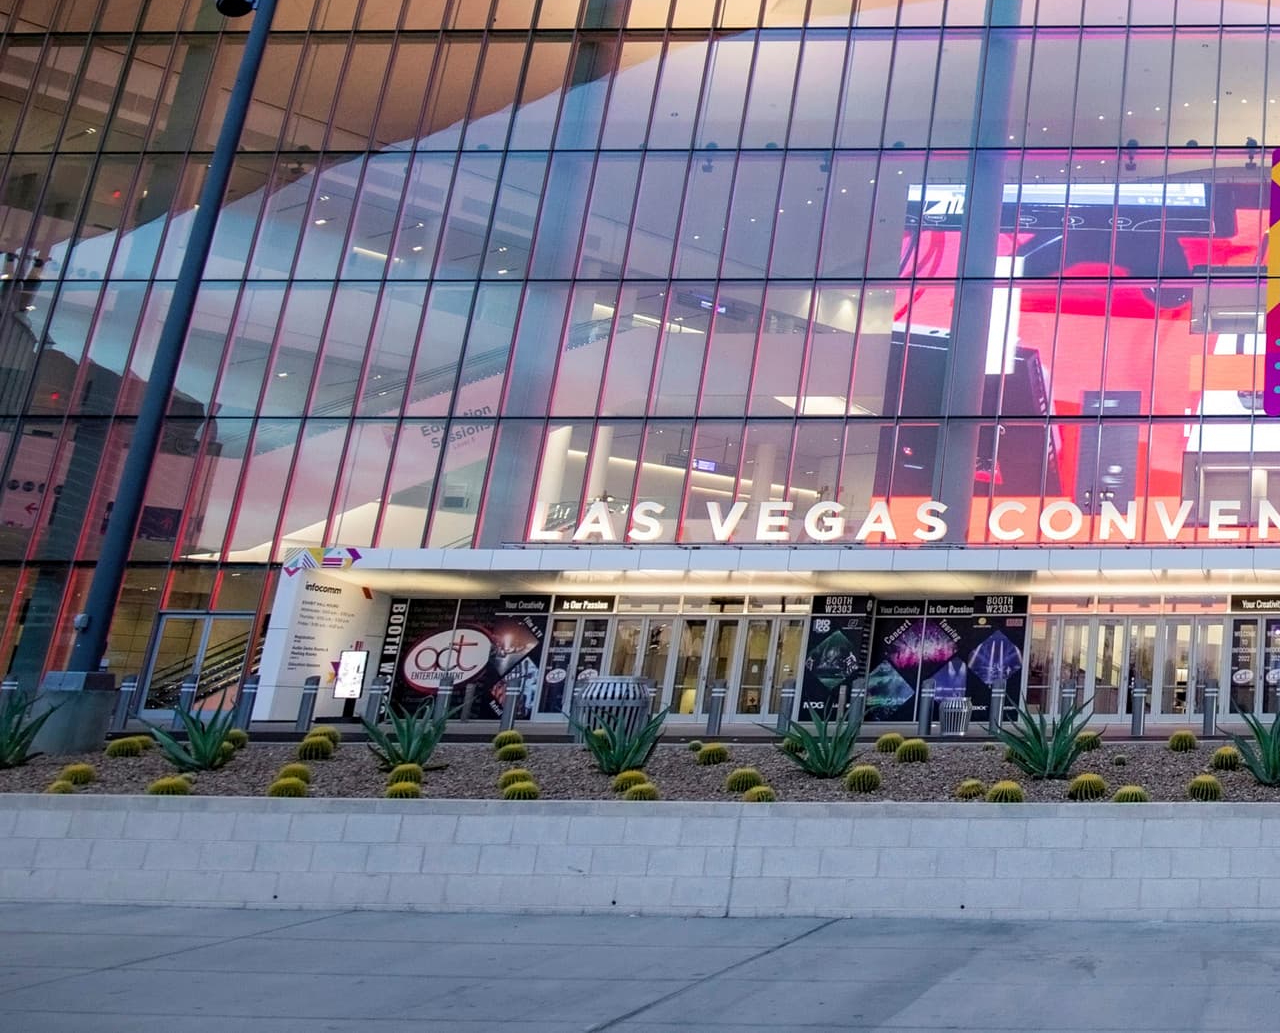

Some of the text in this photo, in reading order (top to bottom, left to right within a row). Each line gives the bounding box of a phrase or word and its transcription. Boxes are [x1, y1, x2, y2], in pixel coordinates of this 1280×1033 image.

[528, 501, 666, 541] LAS
[706, 501, 949, 541] VEGAS
[305, 581, 342, 594] infocomm
[826, 596, 853, 605] BOOTH
[987, 597, 1014, 605] BOOTH
[1242, 600, 1255, 608] Your
[825, 605, 852, 614] W2303
[936, 606, 949, 614] Our
[950, 606, 974, 614] Passion
[986, 605, 1013, 614] W2303
[383, 603, 406, 655] BOOTH
[883, 619, 912, 645] Concert
[939, 619, 962, 643] Touring
